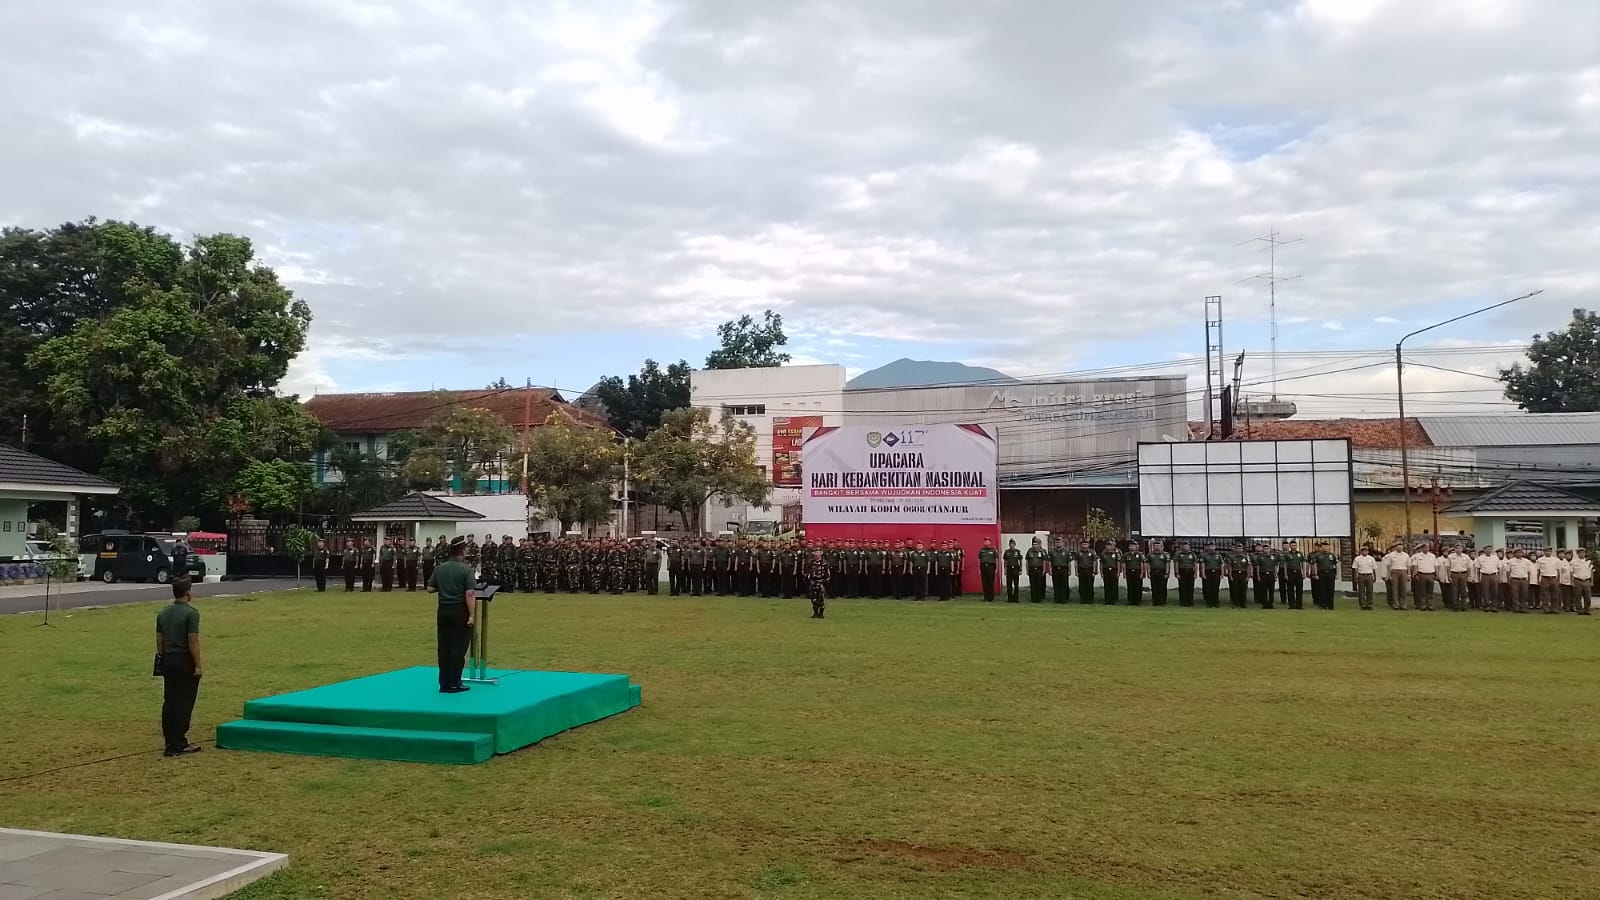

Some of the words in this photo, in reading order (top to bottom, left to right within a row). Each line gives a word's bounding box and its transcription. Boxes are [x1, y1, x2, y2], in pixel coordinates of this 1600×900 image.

[869, 452, 925, 469] UPACARA
[811, 472, 838, 488] HARI
[842, 471, 921, 488] KEBANGKITAN
[925, 471, 987, 488] NASIONAL
[828, 505, 867, 513] WILAYAH
[870, 505, 900, 513] KODIM
